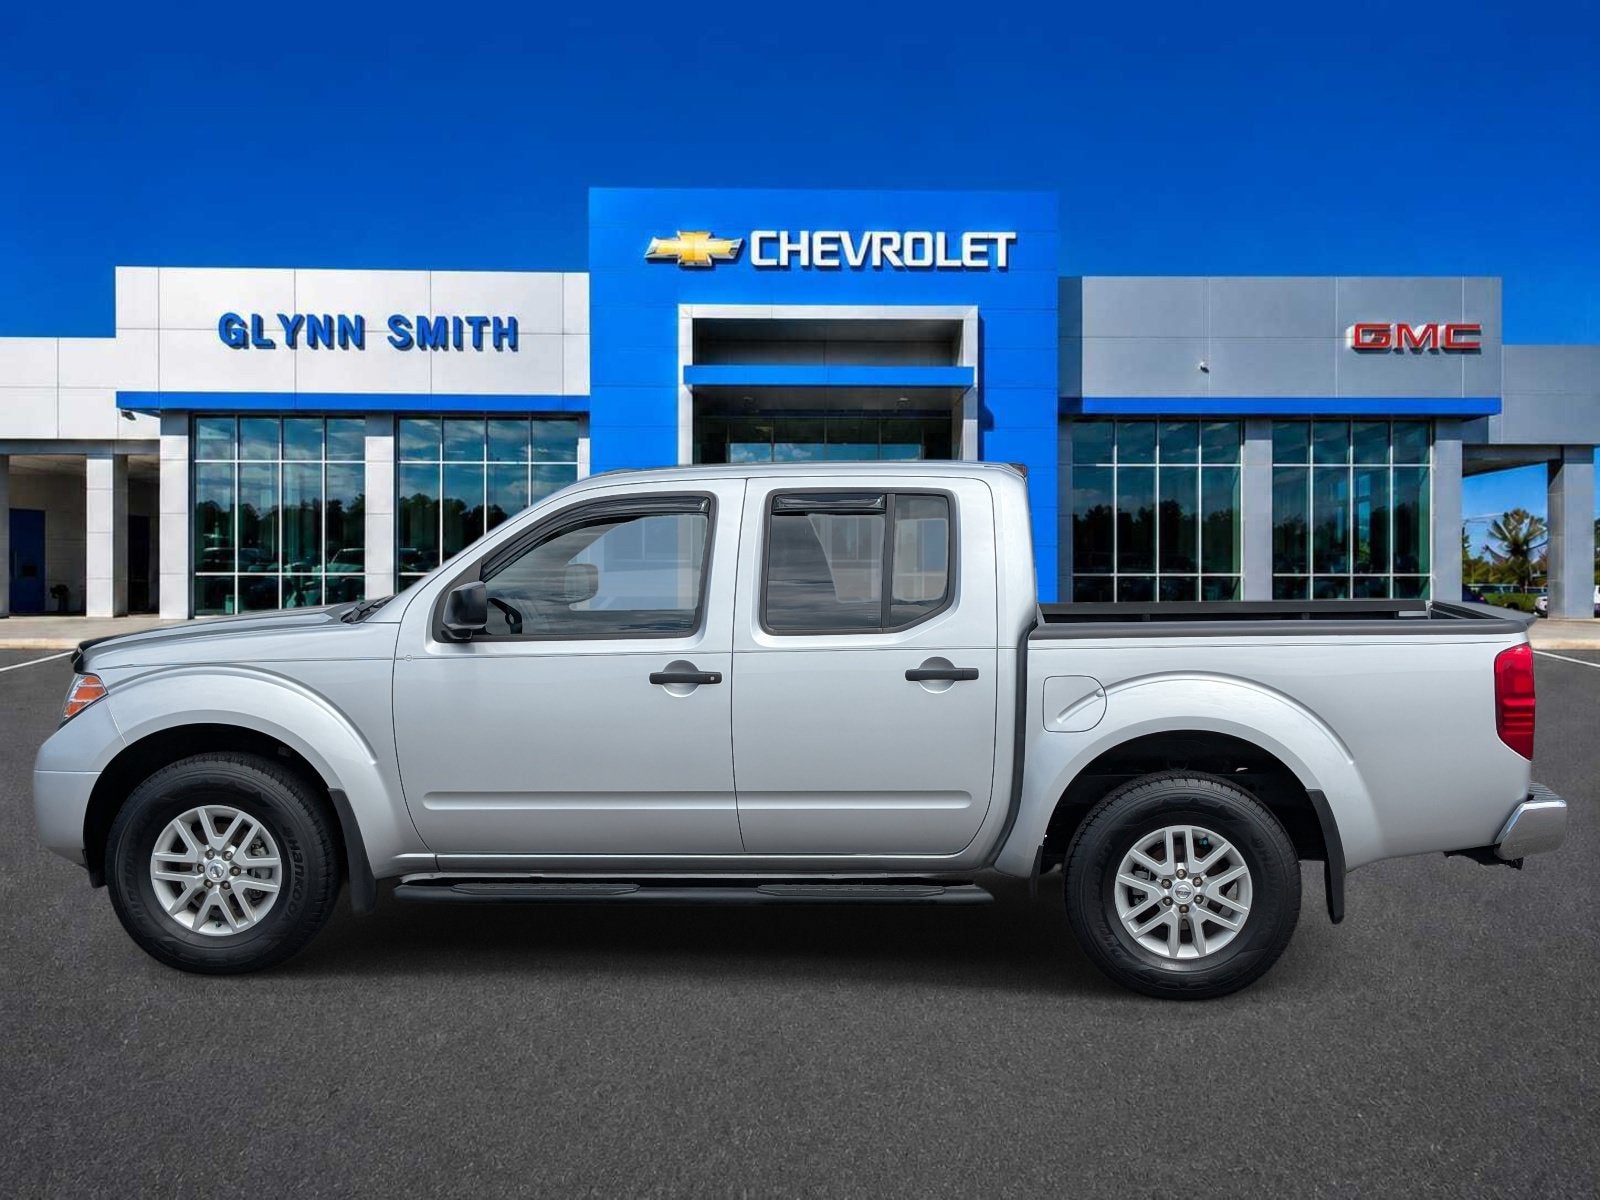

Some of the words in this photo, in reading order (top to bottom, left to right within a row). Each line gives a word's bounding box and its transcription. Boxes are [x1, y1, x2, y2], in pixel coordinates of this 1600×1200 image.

[750, 230, 1016, 269] CHEVROLET
[218, 312, 365, 350] GLYNN
[387, 314, 519, 351] SMITH
[1346, 323, 1482, 353] GMC
